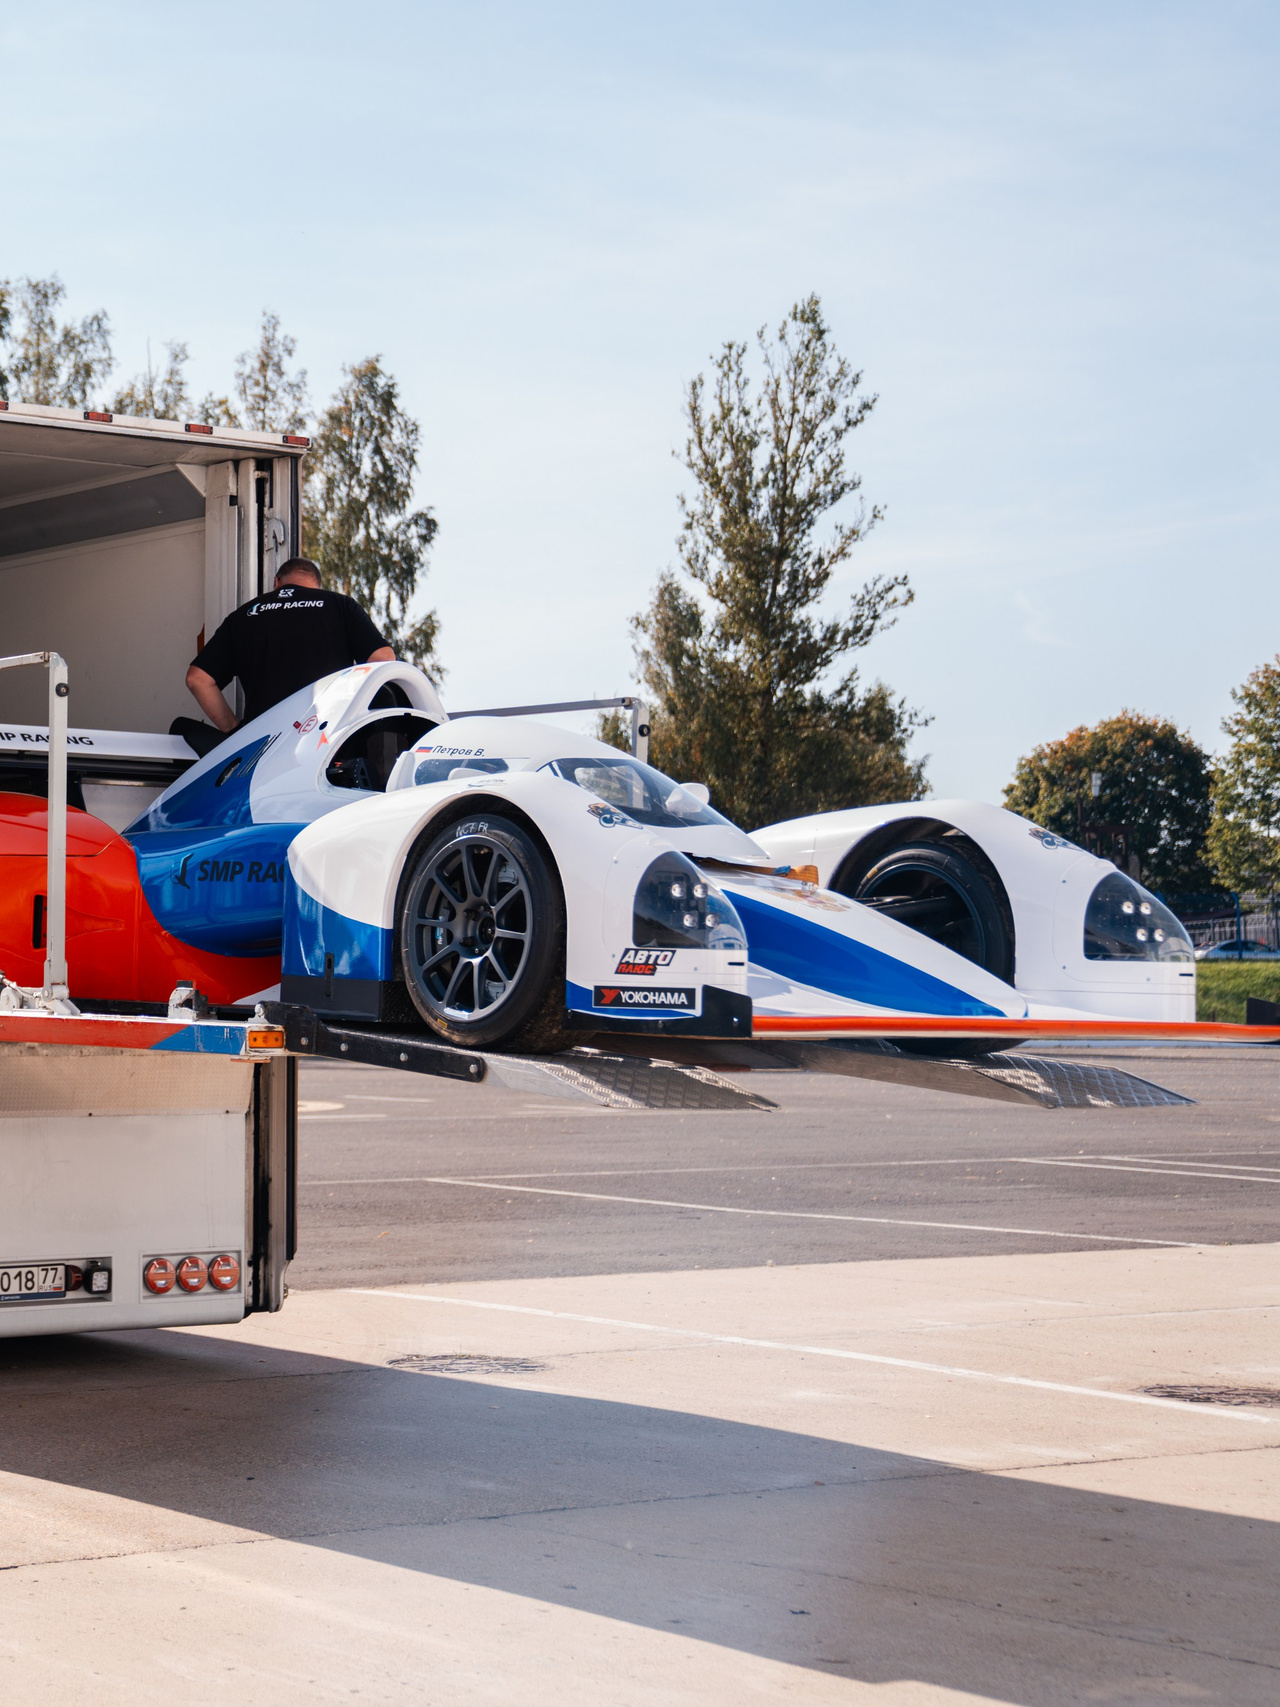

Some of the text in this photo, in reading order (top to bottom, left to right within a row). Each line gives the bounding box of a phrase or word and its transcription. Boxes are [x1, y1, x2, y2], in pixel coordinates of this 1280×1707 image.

[259, 600, 324, 612] SMP RACING
[19, 733, 95, 746] RANG
[432, 745, 473, 756] Петров
[197, 860, 245, 883] SMP
[621, 949, 674, 965] АВТО
[617, 963, 655, 974] ПЛЮС
[619, 990, 689, 1005] YOKOHAMA
[40, 1267, 59, 1285] 77
